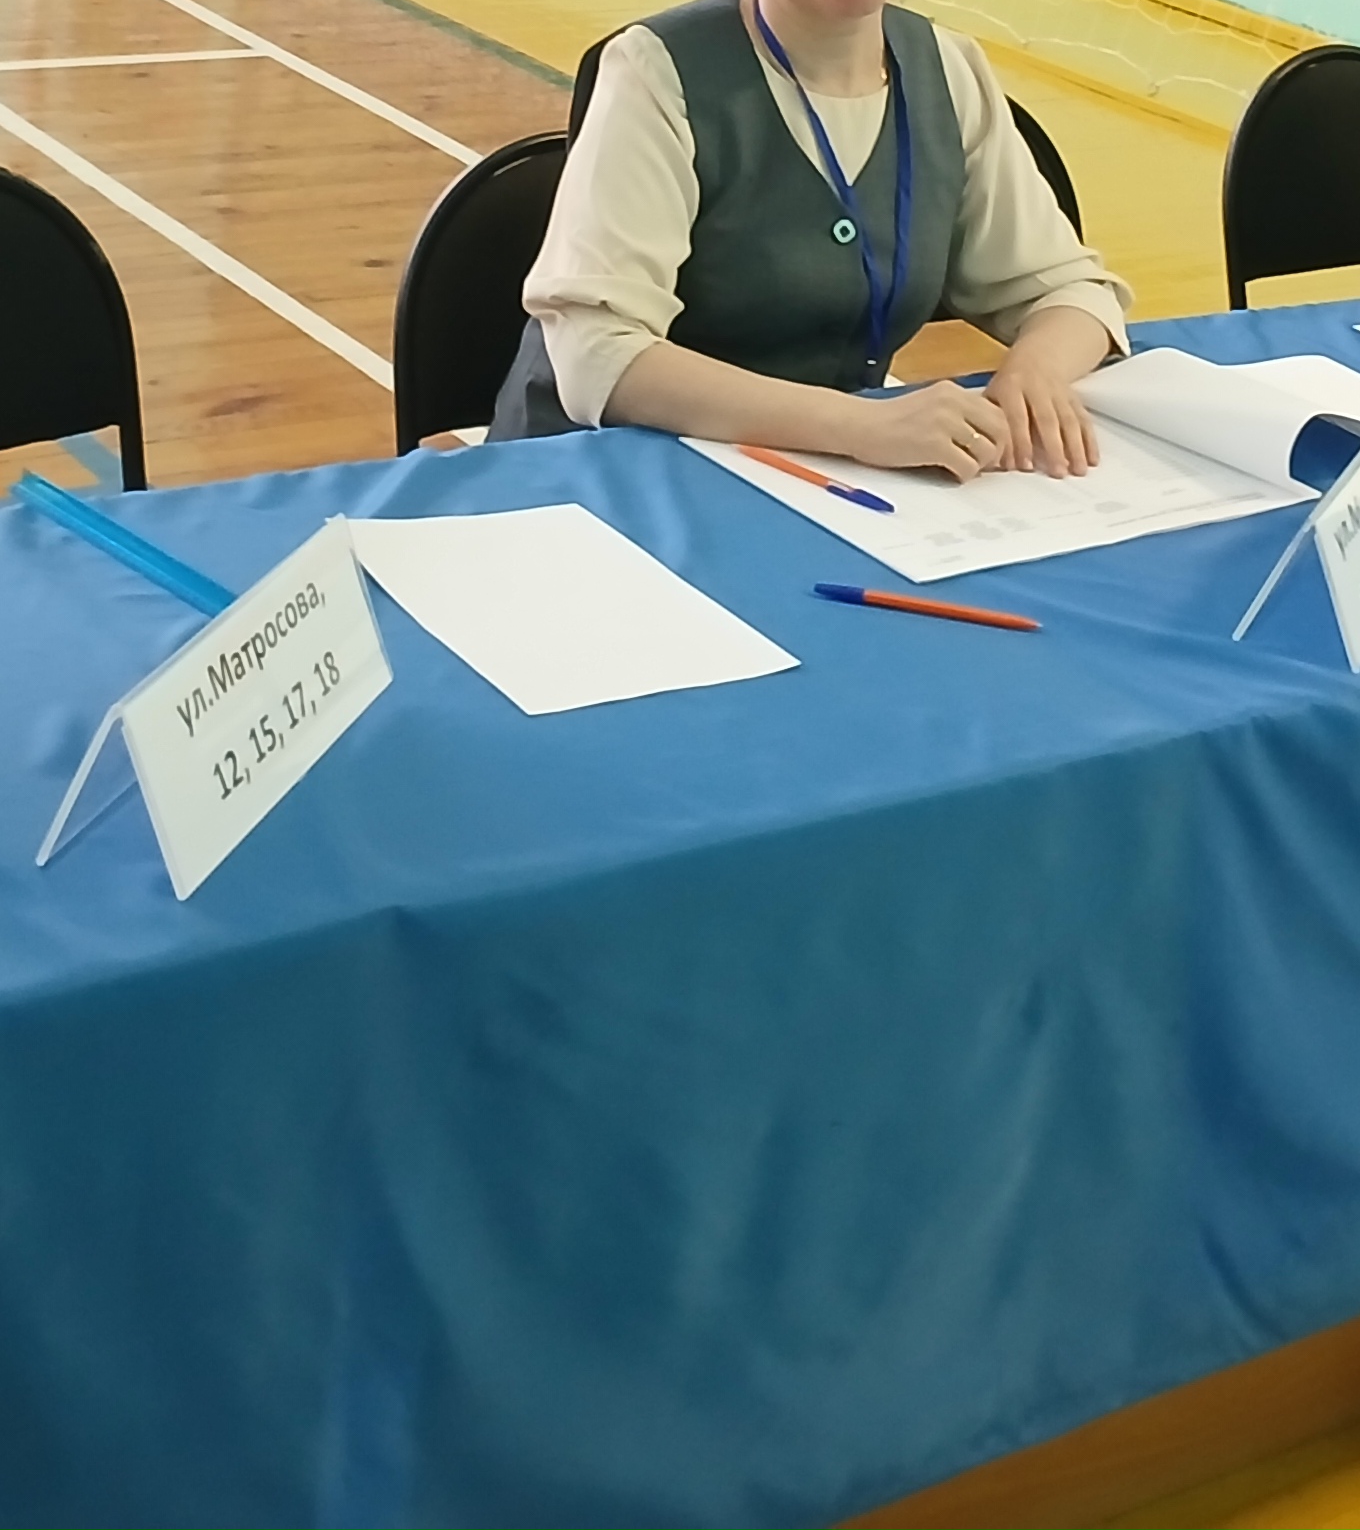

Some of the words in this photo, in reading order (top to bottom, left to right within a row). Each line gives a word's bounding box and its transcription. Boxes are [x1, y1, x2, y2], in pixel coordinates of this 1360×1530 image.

[176, 581, 326, 738] ул.Матросова,
[212, 749, 251, 801] 12,
[248, 713, 285, 764] 15,
[281, 681, 317, 730] 17,
[313, 650, 341, 697] 18
